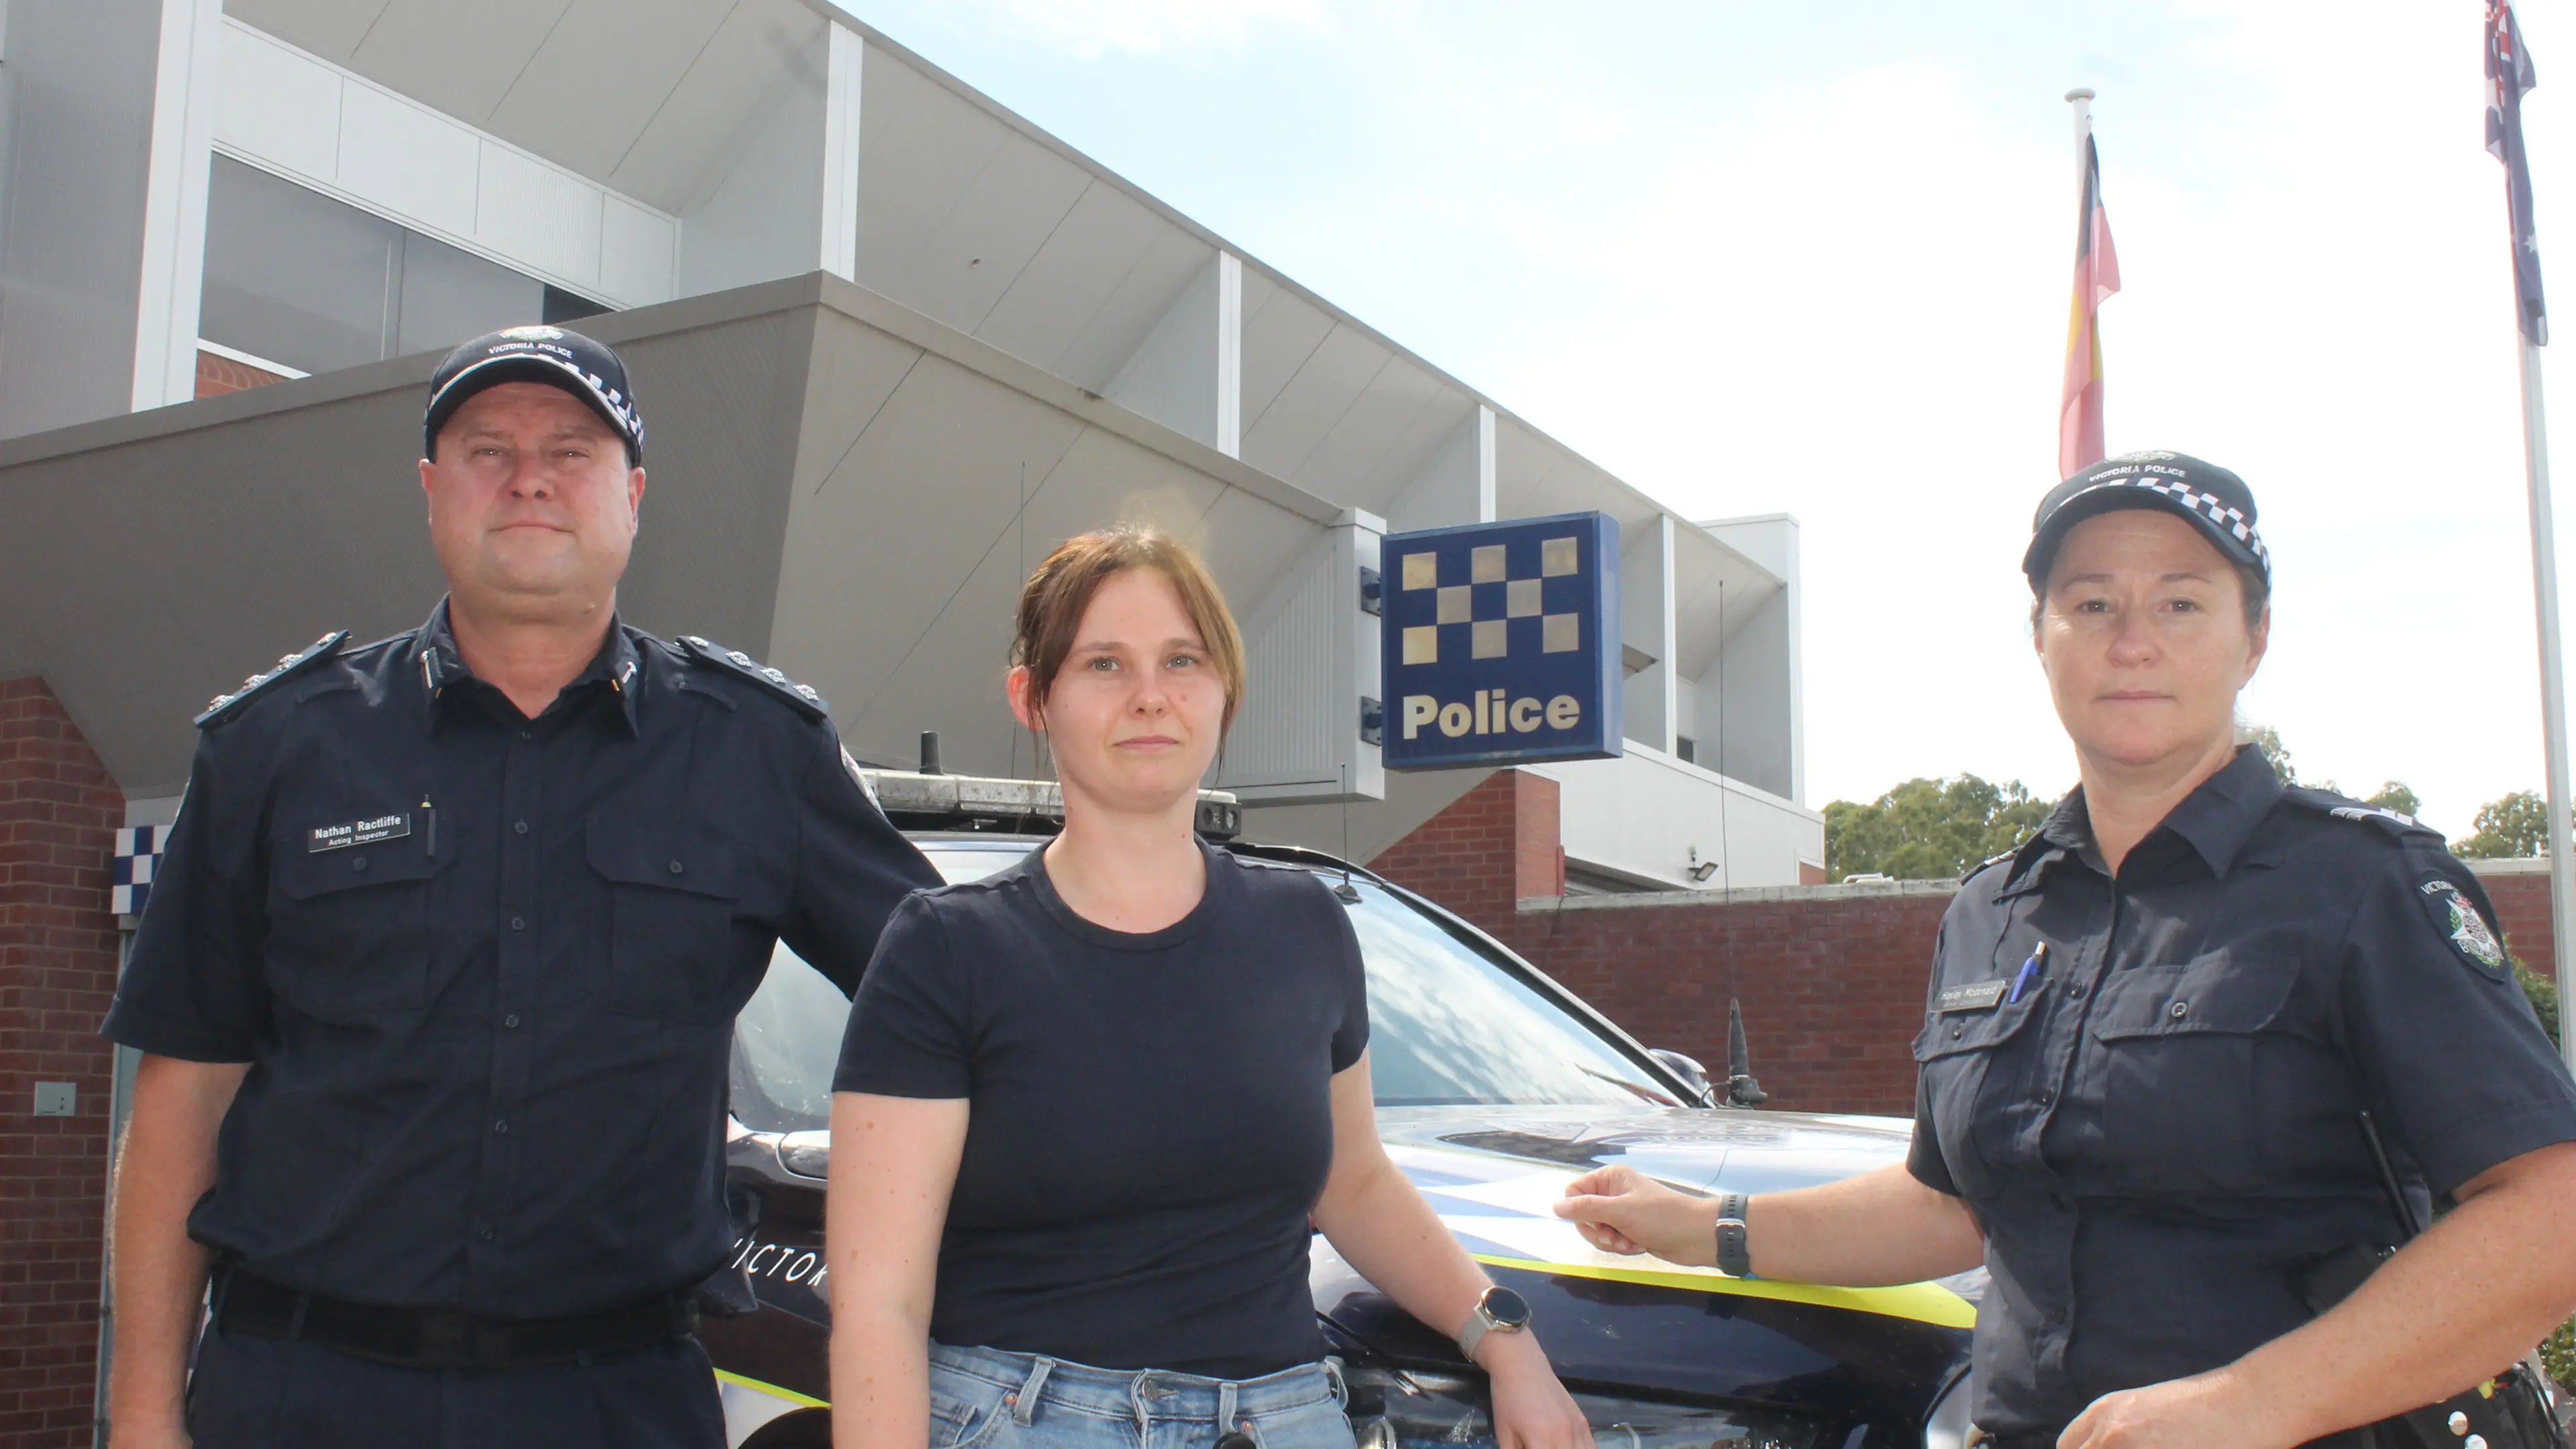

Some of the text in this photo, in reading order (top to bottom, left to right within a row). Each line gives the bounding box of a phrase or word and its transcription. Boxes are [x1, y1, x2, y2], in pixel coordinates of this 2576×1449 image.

[488, 342, 574, 359] VICTORIA POLICE
[2088, 464, 2186, 482] VICTORIA POLICE
[1403, 688, 1580, 740] Police
[315, 815, 401, 839] Nathan Ractliffe
[327, 830, 389, 846] Acting Inspector
